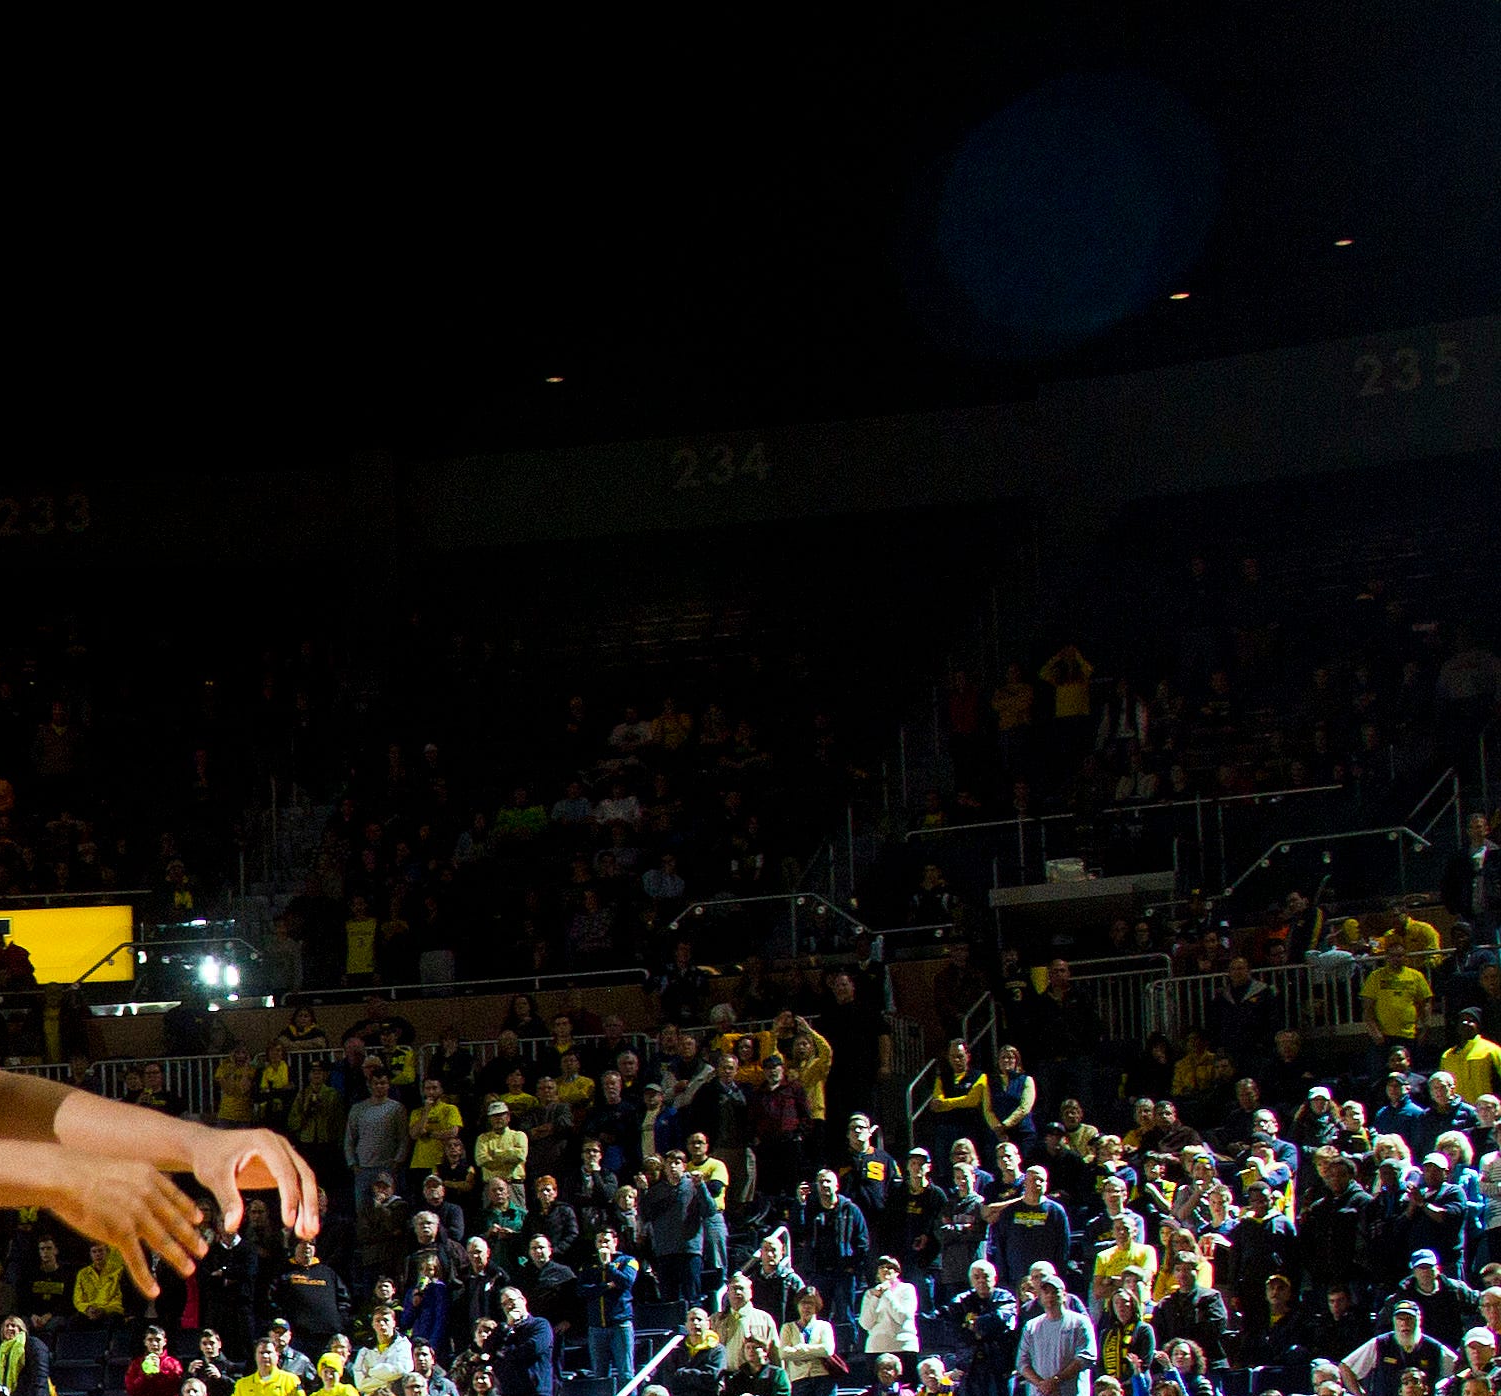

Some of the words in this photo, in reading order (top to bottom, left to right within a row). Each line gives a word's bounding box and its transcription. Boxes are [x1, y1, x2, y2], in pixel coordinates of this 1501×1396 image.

[1354, 340, 1461, 397] 235
[672, 442, 769, 489] 234
[867, 1161, 885, 1182] S
